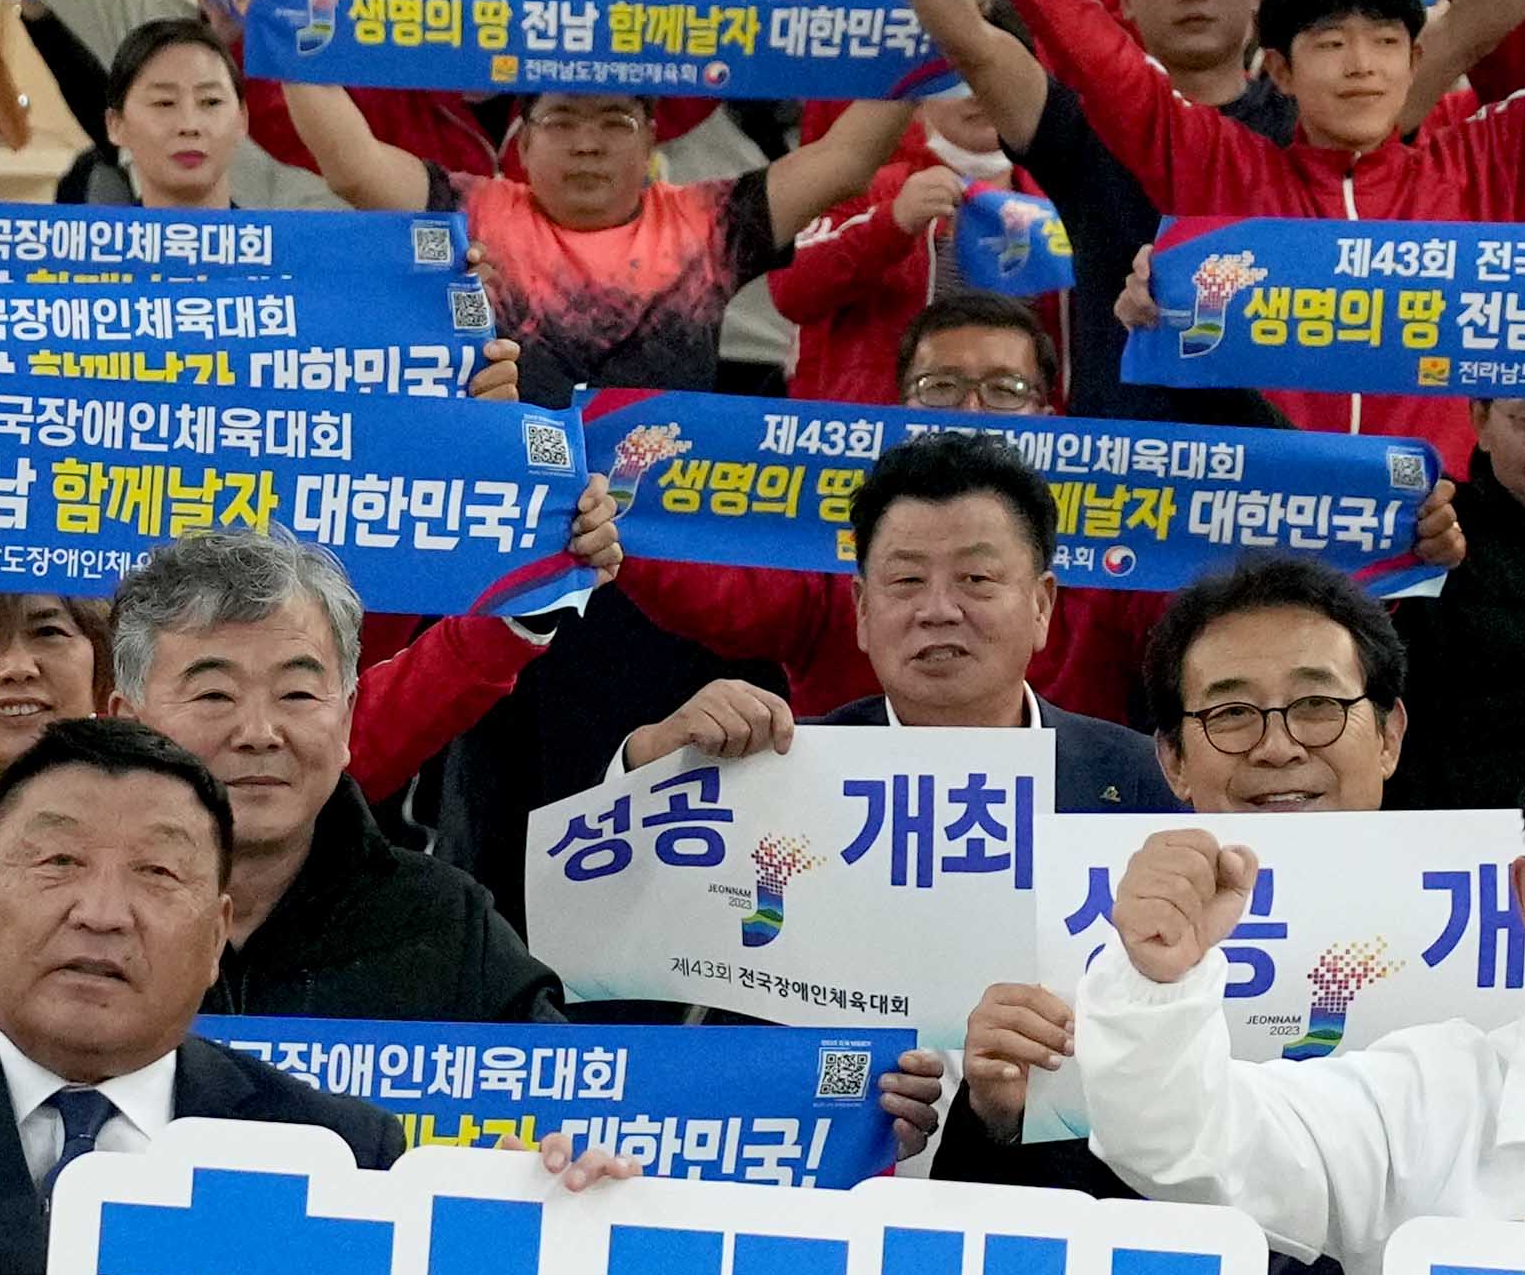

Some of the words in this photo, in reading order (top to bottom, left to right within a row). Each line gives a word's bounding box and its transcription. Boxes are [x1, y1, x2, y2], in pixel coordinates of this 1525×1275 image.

[1335, 239, 1456, 279] 제43회
[1244, 287, 1383, 346] 생명의
[1398, 290, 1446, 348] 땅
[52, 458, 285, 543] 함께날자
[288, 474, 546, 560] 대한민국!
[547, 766, 734, 881] 성공
[840, 773, 1033, 889] 개최
[708, 884, 751, 898] JEONNAM
[729, 897, 752, 909] 2023
[671, 958, 731, 983] 제43회
[739, 967, 908, 1016] 전국장애인체육대회
[1246, 1015, 1302, 1025] JEONNAM
[1269, 1025, 1300, 1036] 2023
